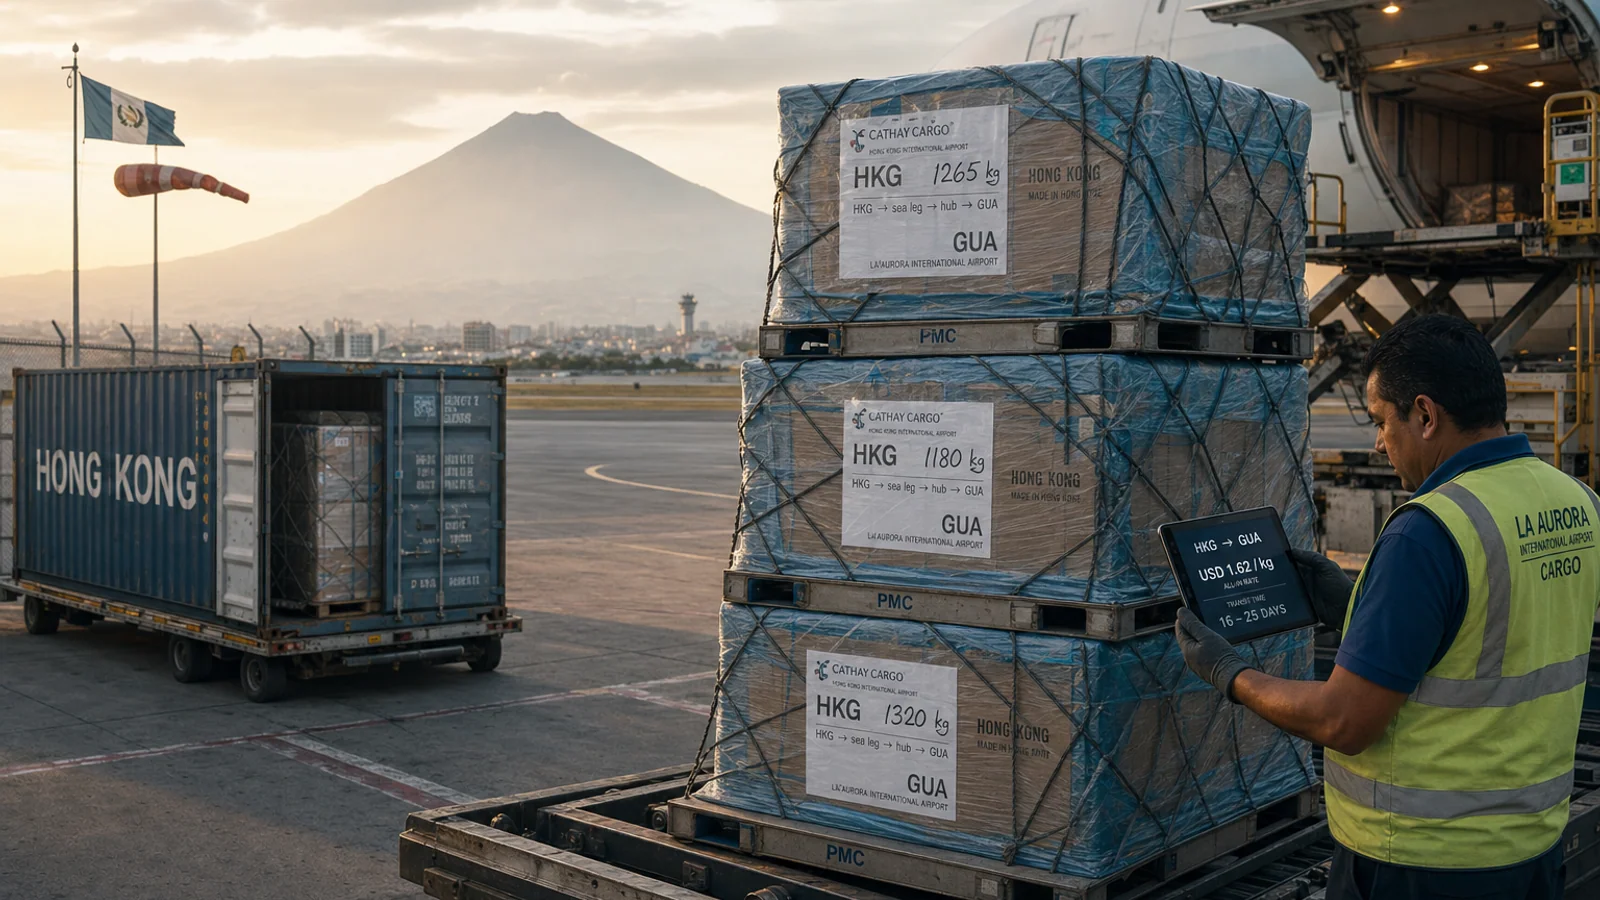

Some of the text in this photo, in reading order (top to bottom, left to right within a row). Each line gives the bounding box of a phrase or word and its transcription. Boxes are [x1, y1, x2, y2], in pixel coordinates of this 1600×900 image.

[869, 124, 950, 141] CATHAY CARGO
[853, 164, 902, 189] HKG
[933, 160, 1000, 186] 1265 kg
[1028, 164, 1101, 183] HONG KONG
[853, 199, 999, 215] HKG sea leg hub GUA
[953, 230, 998, 252] GUA
[911, 258, 966, 269] INTERNATIONAL
[967, 257, 999, 267] AIRPORT
[920, 328, 957, 344] PMC
[868, 411, 941, 424] CATHAY CARGO
[853, 443, 897, 467] HKG
[924, 446, 985, 474] 1180 kg
[36, 448, 198, 511] HONG KONG
[852, 478, 984, 497] HKG sea leg hub GUA
[1011, 469, 1081, 489] HONG KONG
[941, 513, 983, 537] GUA
[1514, 505, 1591, 539] LA AURORA
[1193, 531, 1263, 554] HKG GUA
[1198, 566, 1225, 581] USD
[1540, 555, 1581, 581] CARGO
[877, 592, 913, 610] PMC
[1218, 614, 1234, 628] 16
[1243, 609, 1259, 623] 25
[1260, 603, 1287, 619] DAYS
[831, 663, 904, 682] CATHAY CARGO
[816, 694, 861, 722] HKG
[884, 704, 949, 736] 1320 kg
[977, 718, 1049, 743] HONG KONG
[815, 728, 949, 759] HKG sea leg hub GUA
[907, 773, 948, 799] GUA
[869, 790, 919, 807] INTERNATIONAL
[920, 800, 949, 812] AIRPORT
[826, 843, 865, 867] PMC
